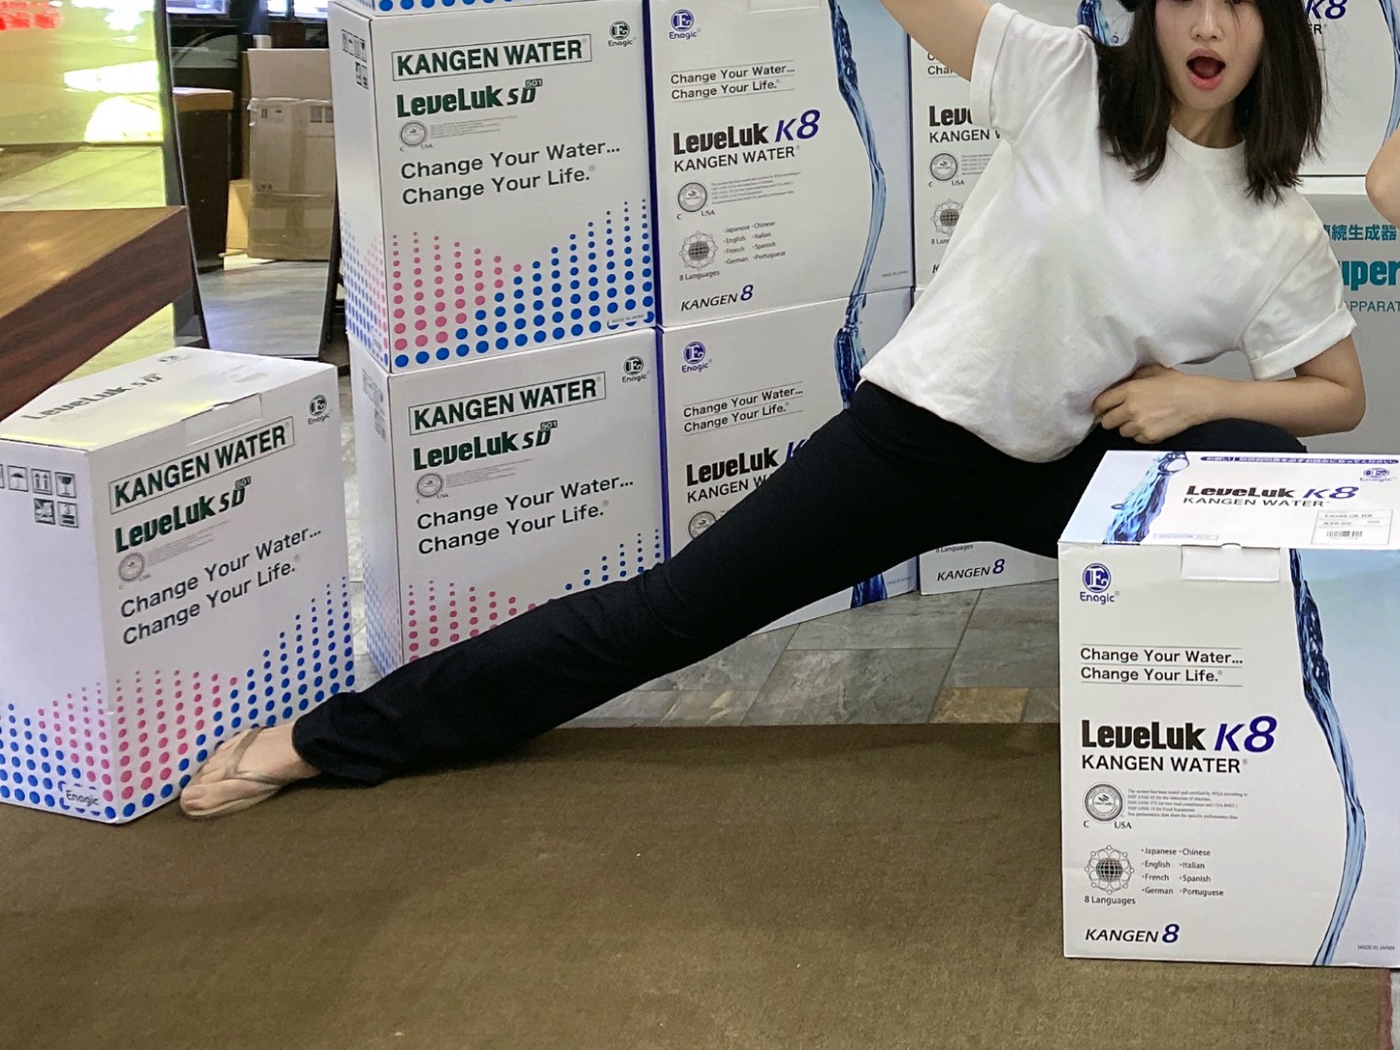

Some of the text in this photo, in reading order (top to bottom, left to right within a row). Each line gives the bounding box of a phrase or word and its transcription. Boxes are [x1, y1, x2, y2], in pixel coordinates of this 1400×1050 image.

[398, 40, 582, 76] KANGEN WATER
[397, 85, 504, 118] LeveLuk
[673, 110, 820, 155] LeveLuk K8
[674, 146, 795, 171] KANGEN WATER
[414, 378, 596, 430] KANGEN WATER
[413, 432, 518, 471] LeveLuk
[114, 424, 286, 507] KANGEN WATER
[1183, 498, 1324, 507] KANGEN WATER
[1186, 486, 1359, 499] LeveLuk K8
[115, 493, 216, 553] LeveLuk
[937, 559, 1005, 581] KANGEN 8
[1080, 592, 1114, 605] Enagic
[1081, 648, 1243, 665] Change Your Water...
[1081, 667, 1218, 682] Change Your Life.
[1082, 716, 1277, 753] LeveLuk K8
[1082, 755, 1240, 773] KANGEN WATER
[66, 790, 99, 806] Enagic
[1114, 822, 1132, 830] USA
[1084, 896, 1136, 906] 8 Languages
[1085, 924, 1180, 943] KANGEN 8
